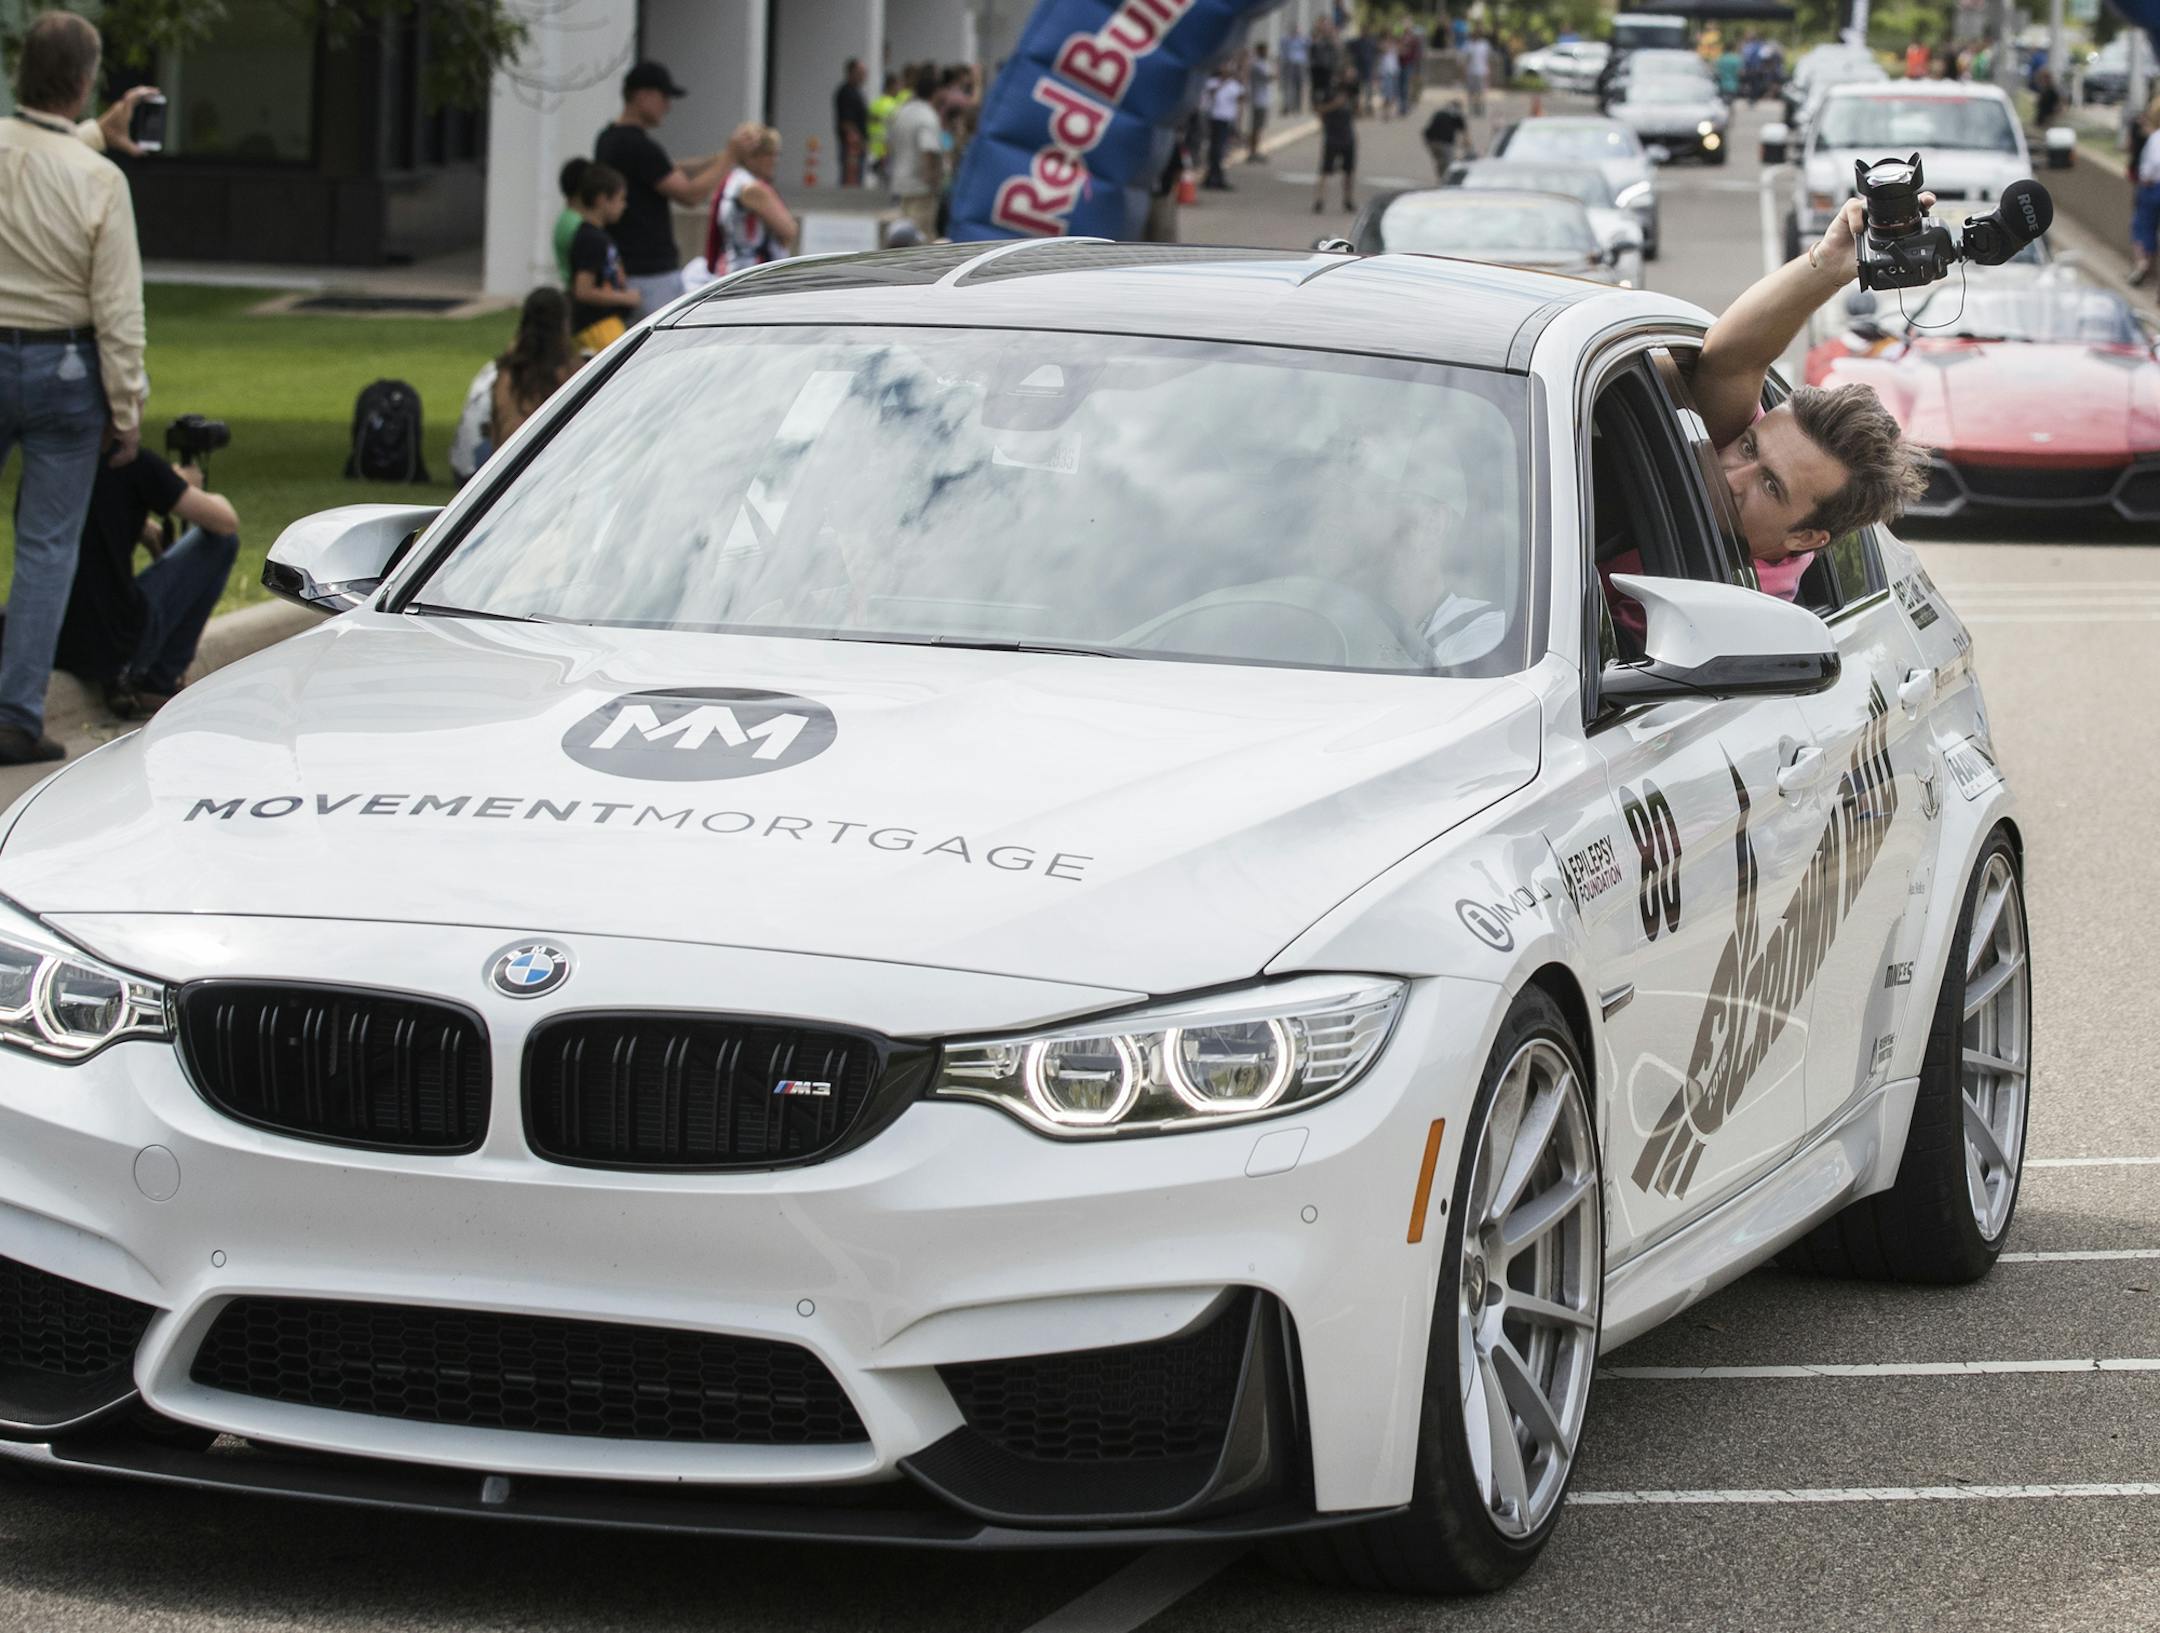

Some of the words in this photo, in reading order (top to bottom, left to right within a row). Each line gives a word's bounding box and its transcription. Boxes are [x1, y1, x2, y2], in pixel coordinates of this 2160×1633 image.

[993, 78, 1110, 237] Red
[1057, 0, 1192, 102] Bul
[1568, 834, 1617, 885] EPILEPSY
[1618, 778, 1682, 943] 80
[1578, 863, 1624, 906] FOUNDATION
[507, 944, 566, 964] BMW
[790, 1080, 832, 1096] M3
